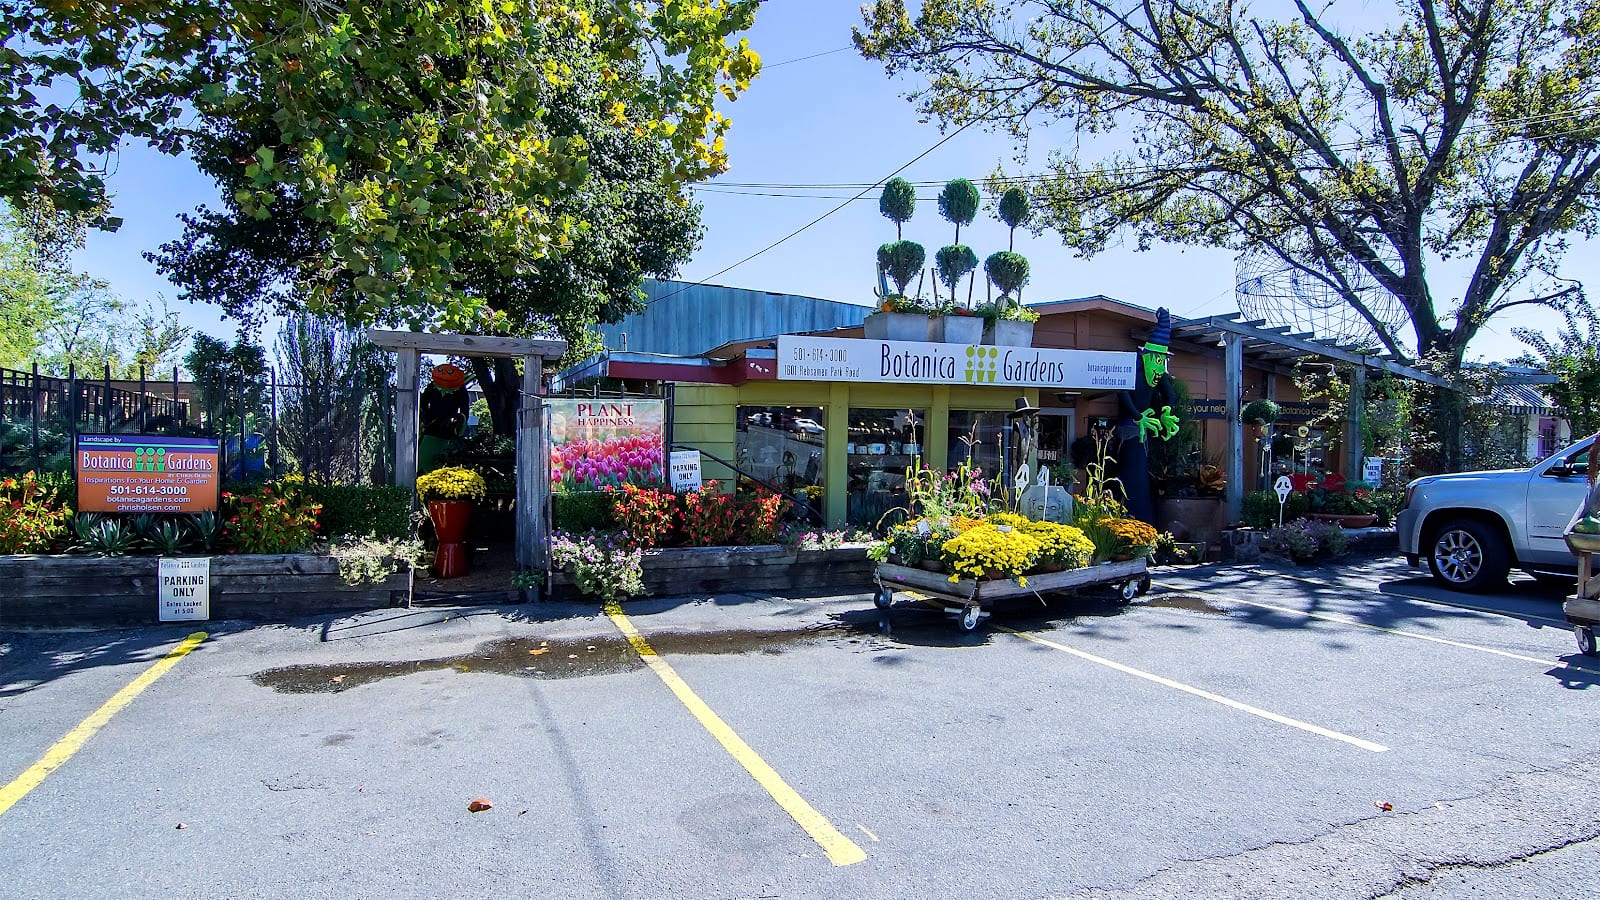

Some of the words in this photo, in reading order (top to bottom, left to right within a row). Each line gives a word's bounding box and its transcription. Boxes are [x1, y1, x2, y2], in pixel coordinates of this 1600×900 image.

[881, 343, 955, 379] Botanica
[1003, 350, 1064, 383] Gardens
[784, 364, 797, 376] 1601
[830, 367, 843, 377] Park
[845, 367, 860, 378] Road
[577, 403, 633, 417] PLANT
[1193, 405, 1209, 414] your
[577, 417, 634, 426] HAPPINESS
[83, 452, 132, 469] Botanica
[168, 453, 212, 470] Gardens
[678, 472, 693, 480] ONLY
[110, 486, 187, 495] 501-614-3000
[106, 496, 191, 504] botanicagardens.com
[164, 575, 204, 586] PARKING
[173, 587, 195, 597] ONLY
